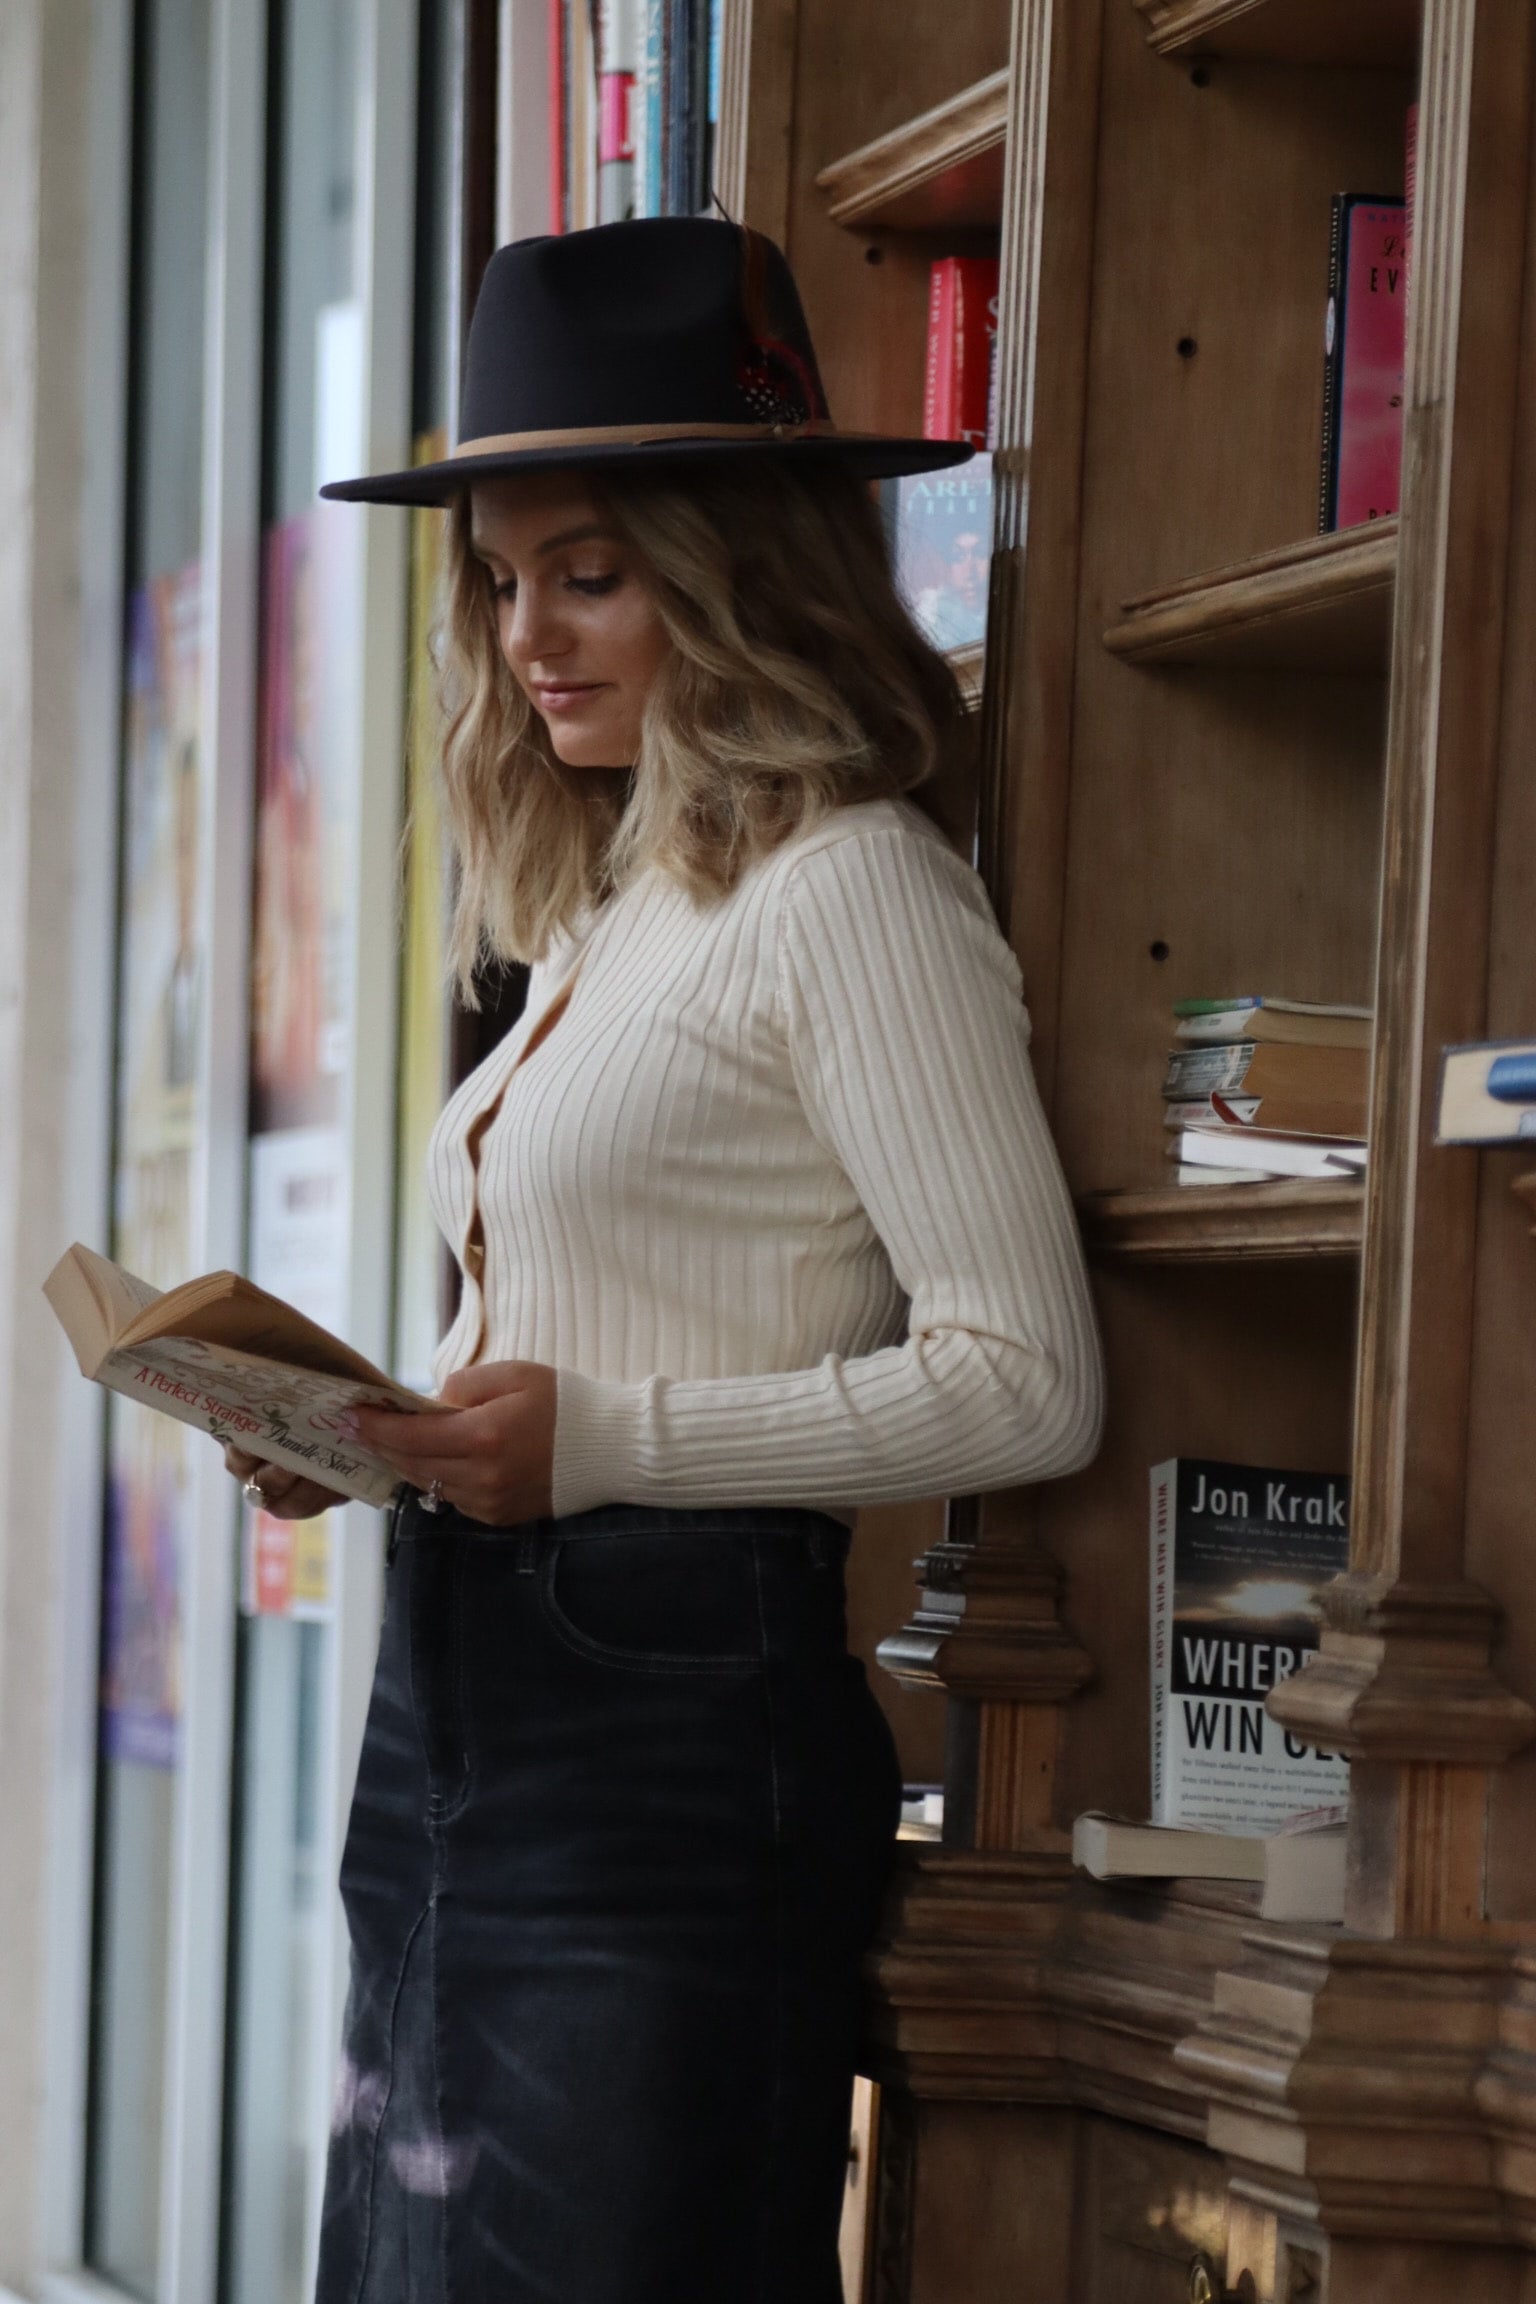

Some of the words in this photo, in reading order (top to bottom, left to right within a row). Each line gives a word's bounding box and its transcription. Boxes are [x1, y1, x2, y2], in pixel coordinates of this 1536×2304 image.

[134, 1366, 149, 1383] A
[149, 1371, 201, 1406] Perfect
[201, 1396, 263, 1433] Stranger
[262, 1424, 324, 1462] Danielle
[319, 1447, 368, 1480] Steel
[1191, 1474, 1248, 1518] Jon
[1267, 1482, 1346, 1526] Krak
[1156, 1543, 1166, 1576] MEN
[1156, 1581, 1166, 1613] WIN
[1155, 1619, 1165, 1669] GLORY
[1154, 1684, 1163, 1714] JON
[1183, 1701, 1263, 1755] WIN
